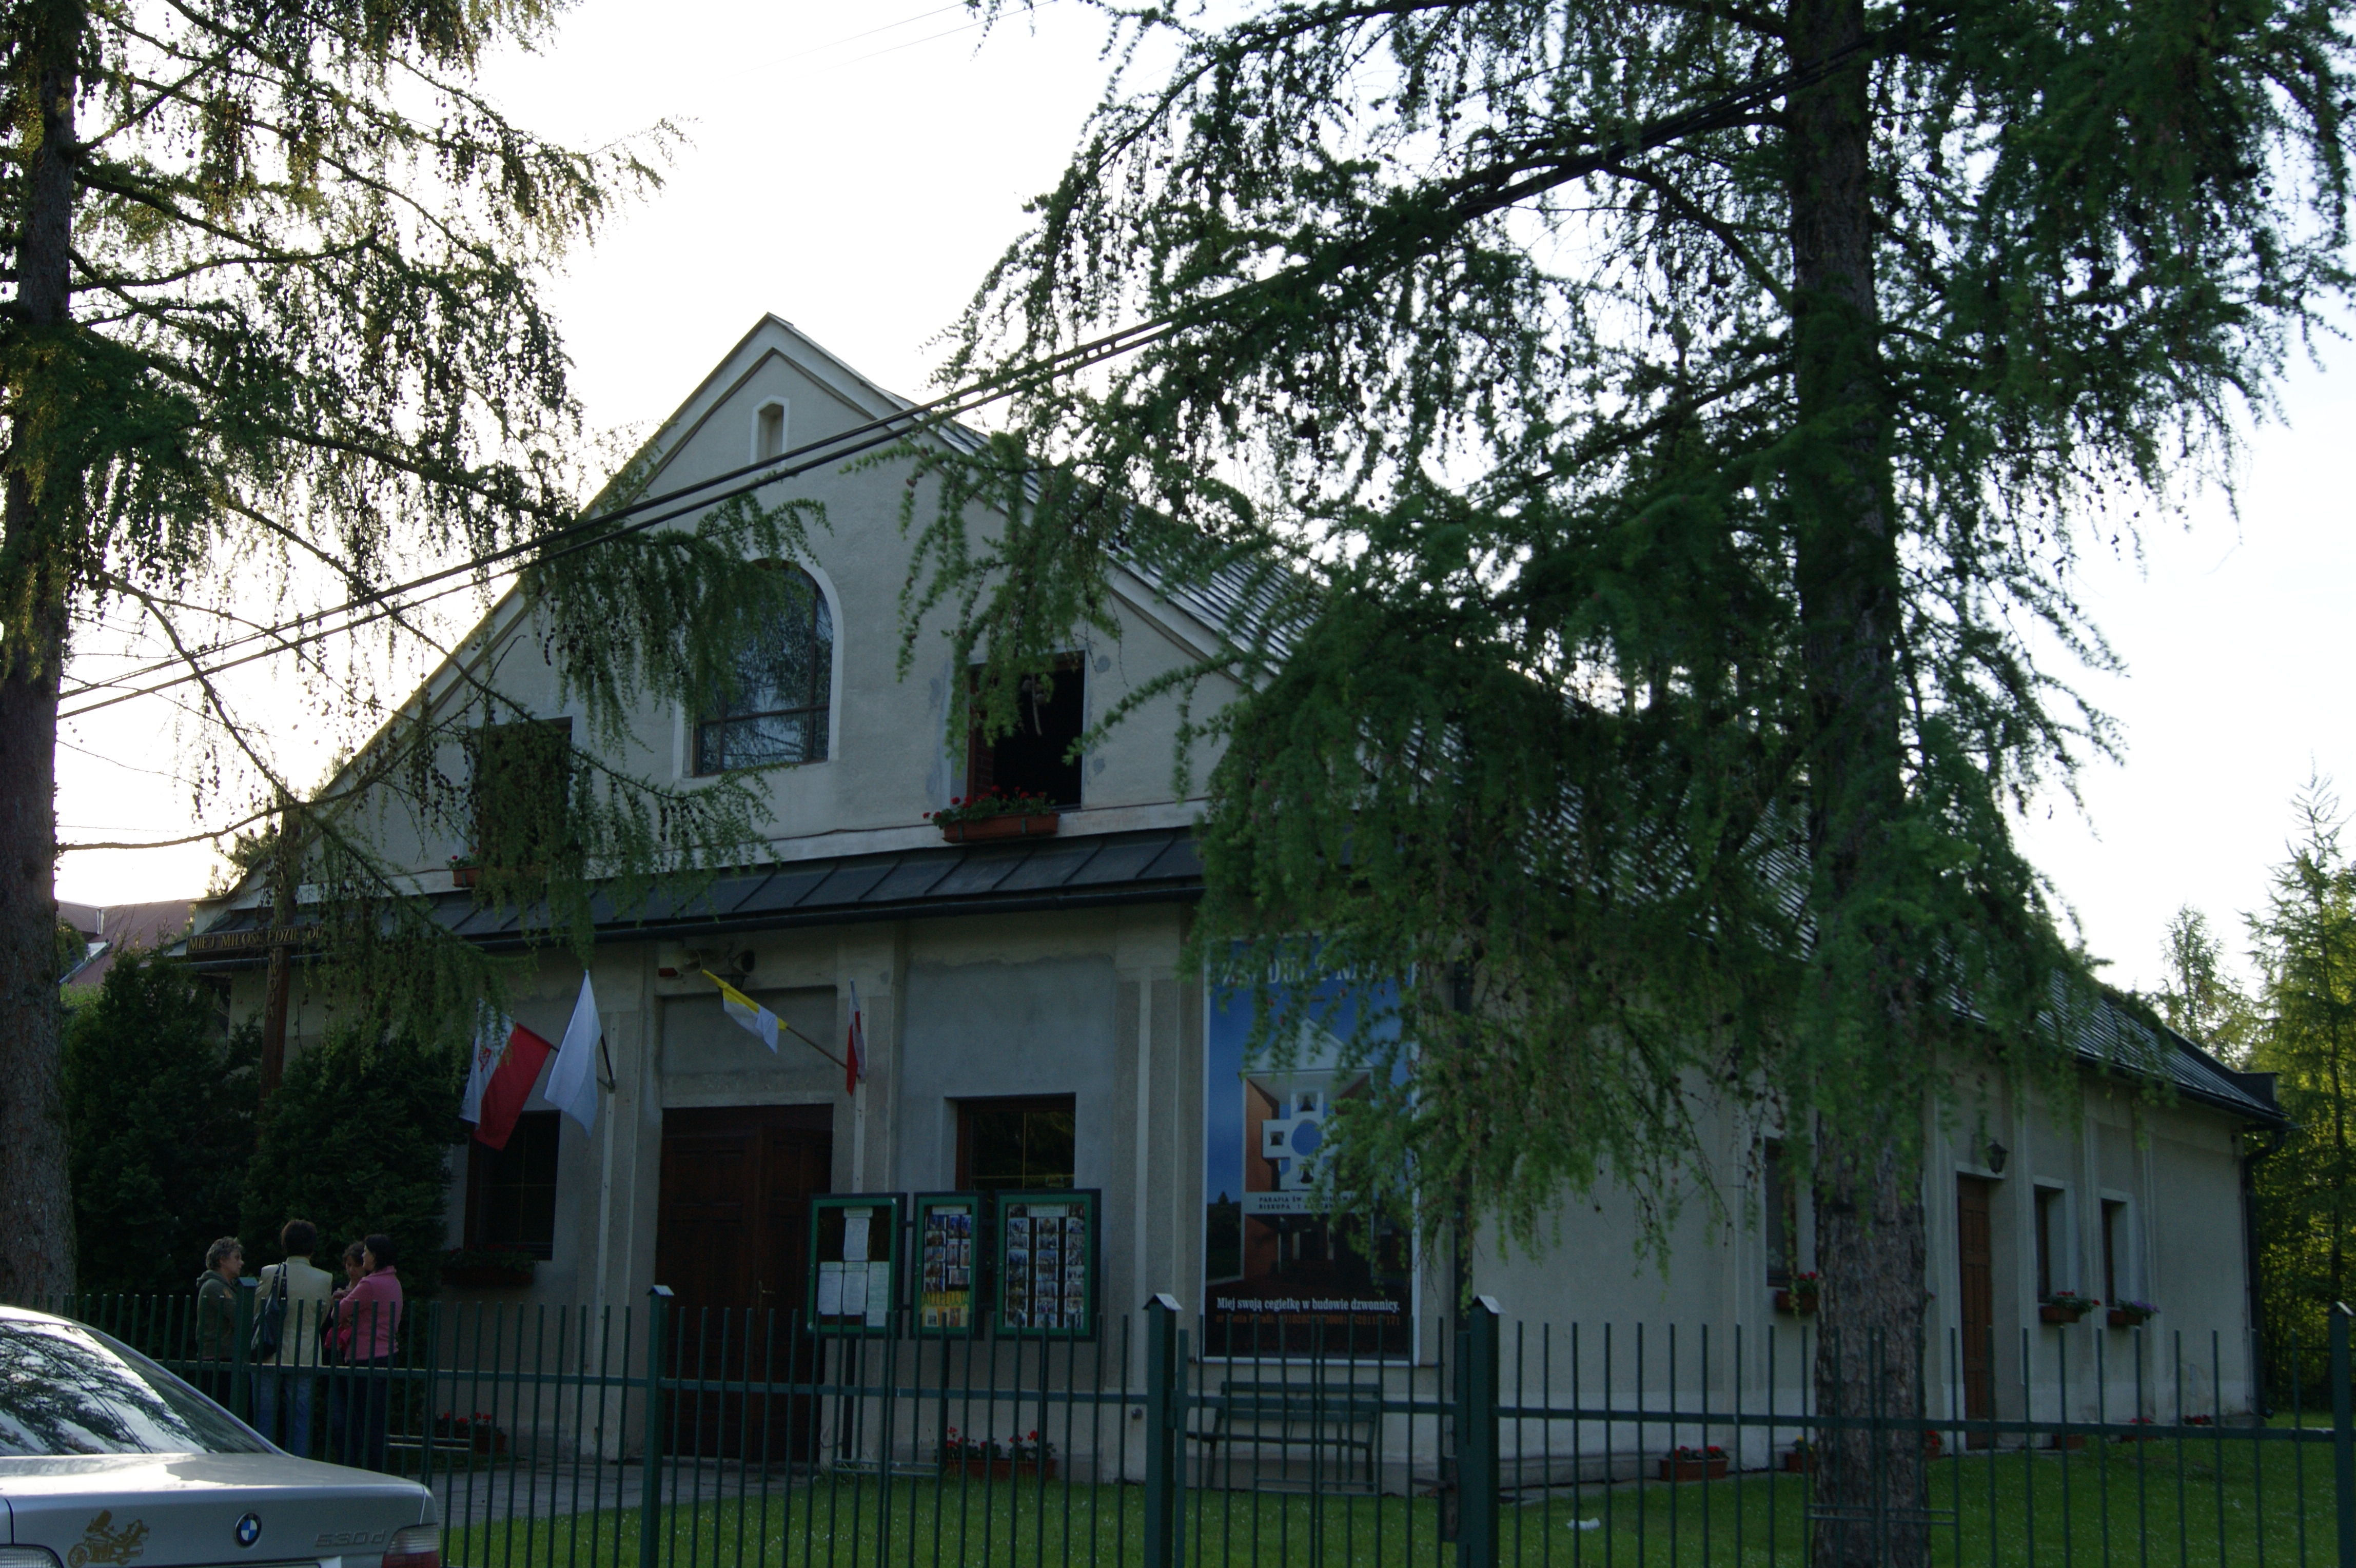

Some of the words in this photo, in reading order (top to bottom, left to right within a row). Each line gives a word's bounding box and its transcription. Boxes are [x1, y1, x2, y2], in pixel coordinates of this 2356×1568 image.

[188, 936, 215, 951] MIEJ
[1216, 1297, 1235, 1311] Miej
[1237, 1297, 1262, 1312] swoją
[1302, 1301, 1309, 1310] w
[1312, 1297, 1349, 1311] budowie
[1350, 1298, 1400, 1313] dzwonnicy.
